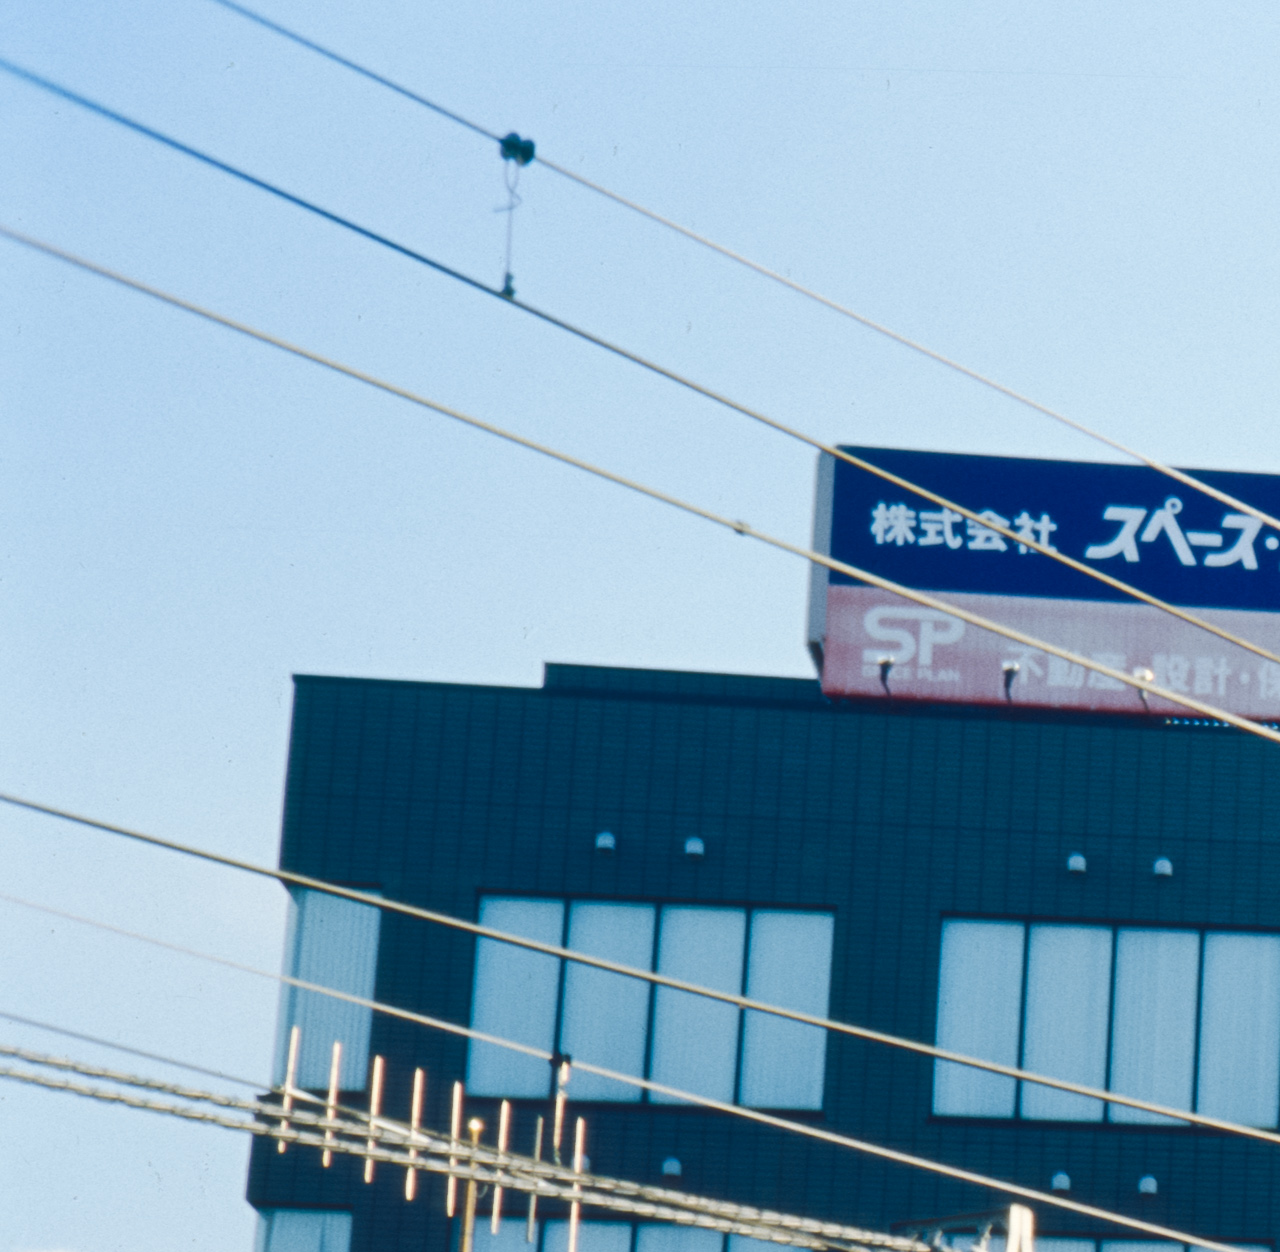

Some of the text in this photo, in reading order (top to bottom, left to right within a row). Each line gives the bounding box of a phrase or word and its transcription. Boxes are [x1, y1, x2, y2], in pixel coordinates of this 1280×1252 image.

[871, 502, 1058, 554] 株式会社
[863, 604, 966, 667] SP
